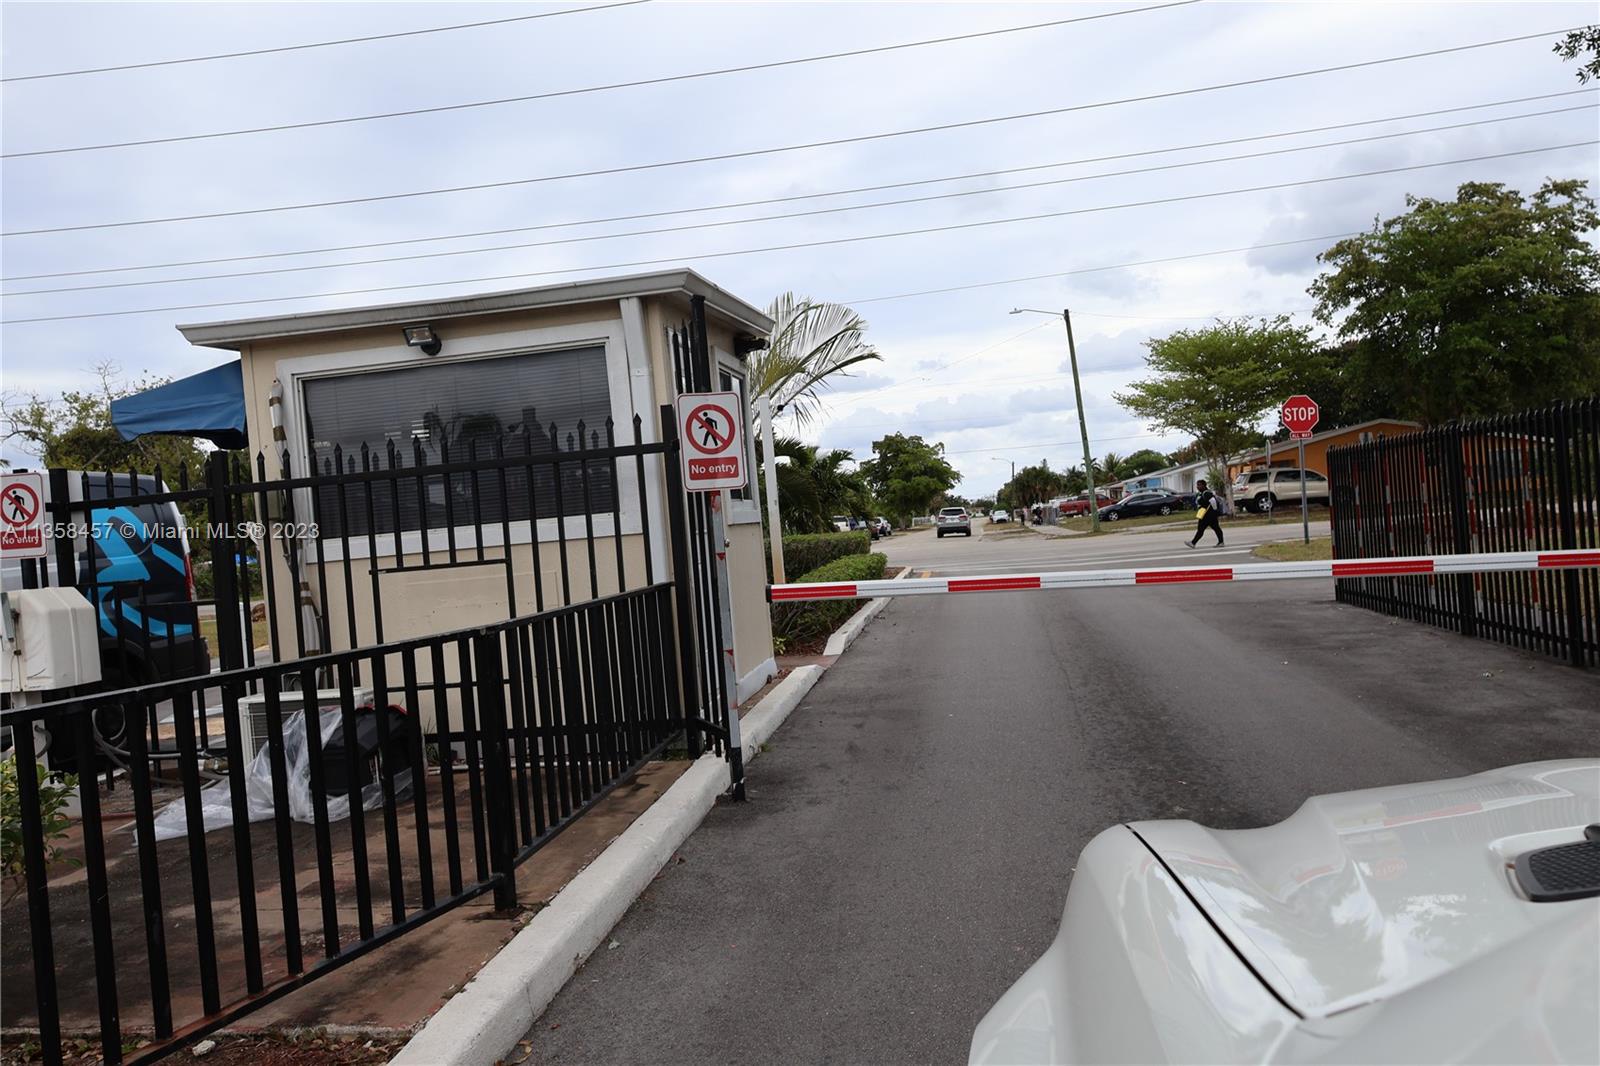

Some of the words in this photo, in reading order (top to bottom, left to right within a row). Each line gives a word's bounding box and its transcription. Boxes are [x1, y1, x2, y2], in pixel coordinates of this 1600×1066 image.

[1284, 407, 1316, 422] STOP
[691, 464, 706, 474] No
[708, 463, 736, 474] entry
[2, 536, 15, 545] No
[17, 535, 40, 545] entry
